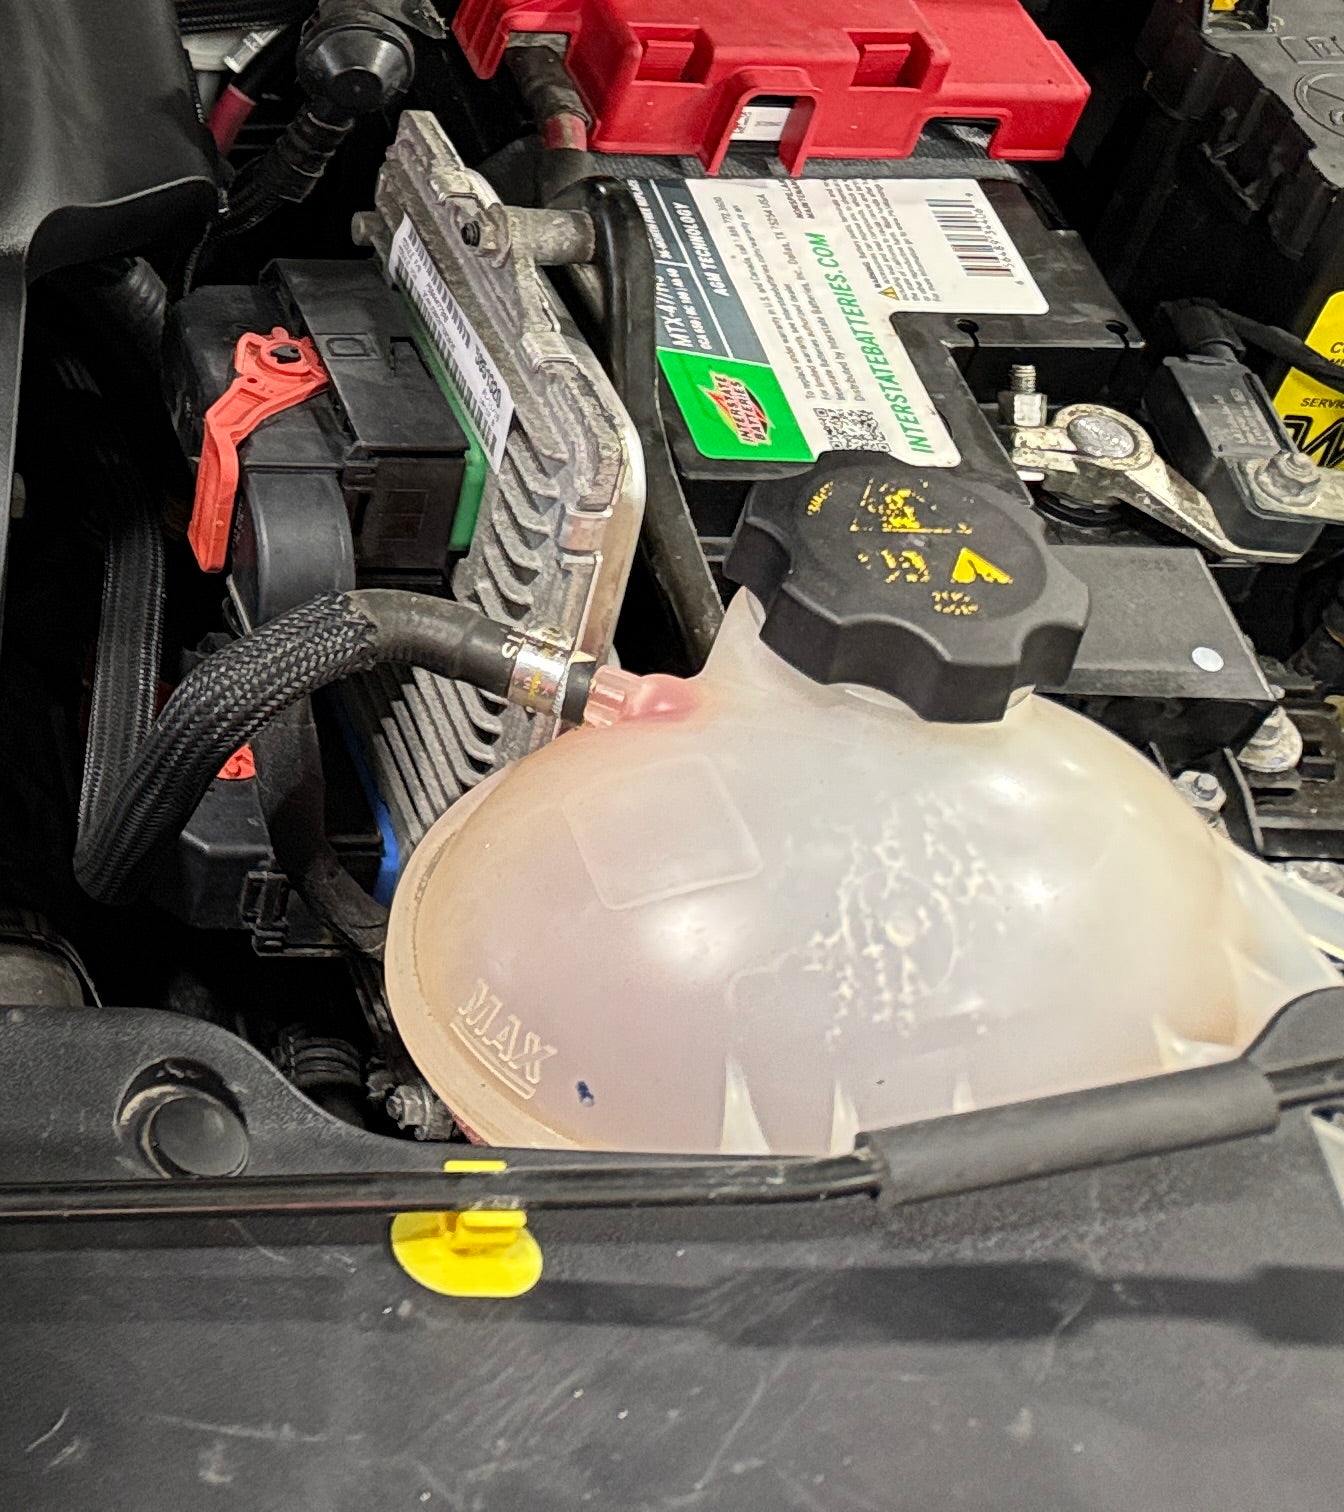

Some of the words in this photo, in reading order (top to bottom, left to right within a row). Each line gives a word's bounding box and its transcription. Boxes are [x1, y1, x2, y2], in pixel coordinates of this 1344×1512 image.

[671, 201, 712, 268] TECHNOLOGY
[702, 271, 730, 295] AGM
[804, 232, 934, 453] INTERSTATEBATTERIES.COM
[714, 376, 753, 441] INTERSTATE
[730, 381, 765, 439] BATTERIES
[458, 977, 558, 1084] MAX
